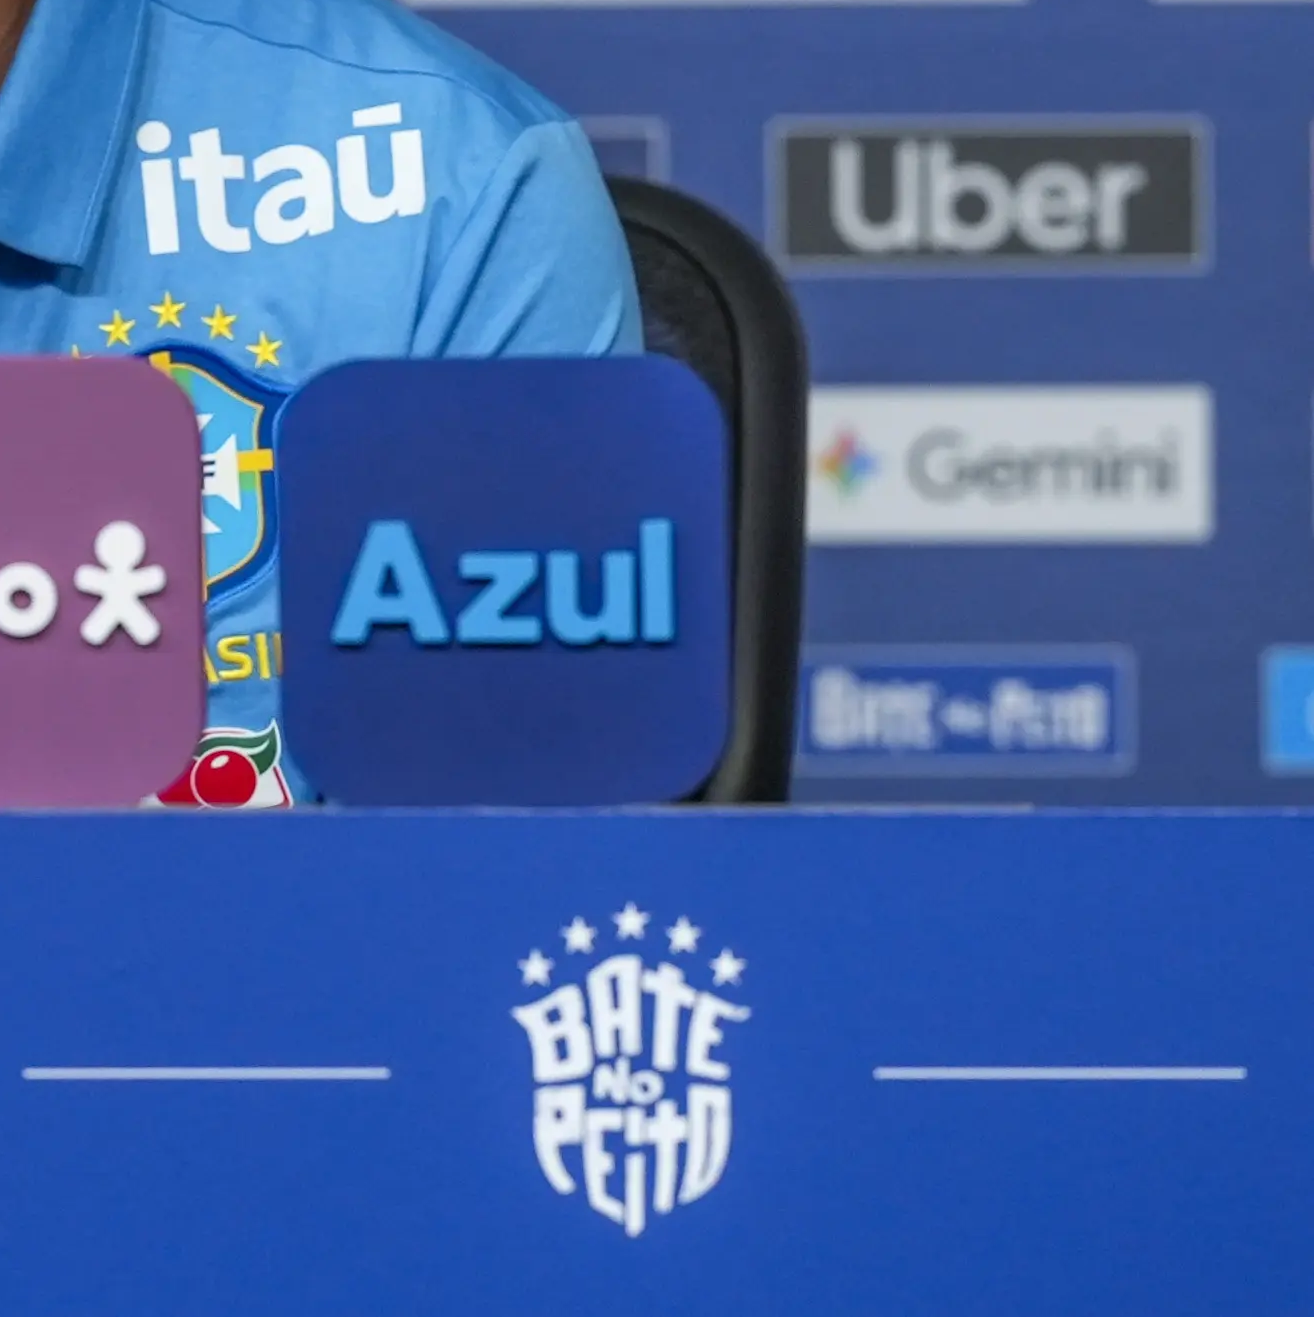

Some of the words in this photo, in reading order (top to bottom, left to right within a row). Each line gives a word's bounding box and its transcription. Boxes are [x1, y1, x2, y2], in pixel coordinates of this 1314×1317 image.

[136, 104, 425, 255] itaú
[834, 142, 1141, 251] Uber
[906, 427, 1180, 505] Gemini
[333, 519, 672, 650] Azul
[511, 954, 752, 1083] BATE
[592, 1056, 665, 1105] NO
[533, 1083, 732, 1238] PEITO
